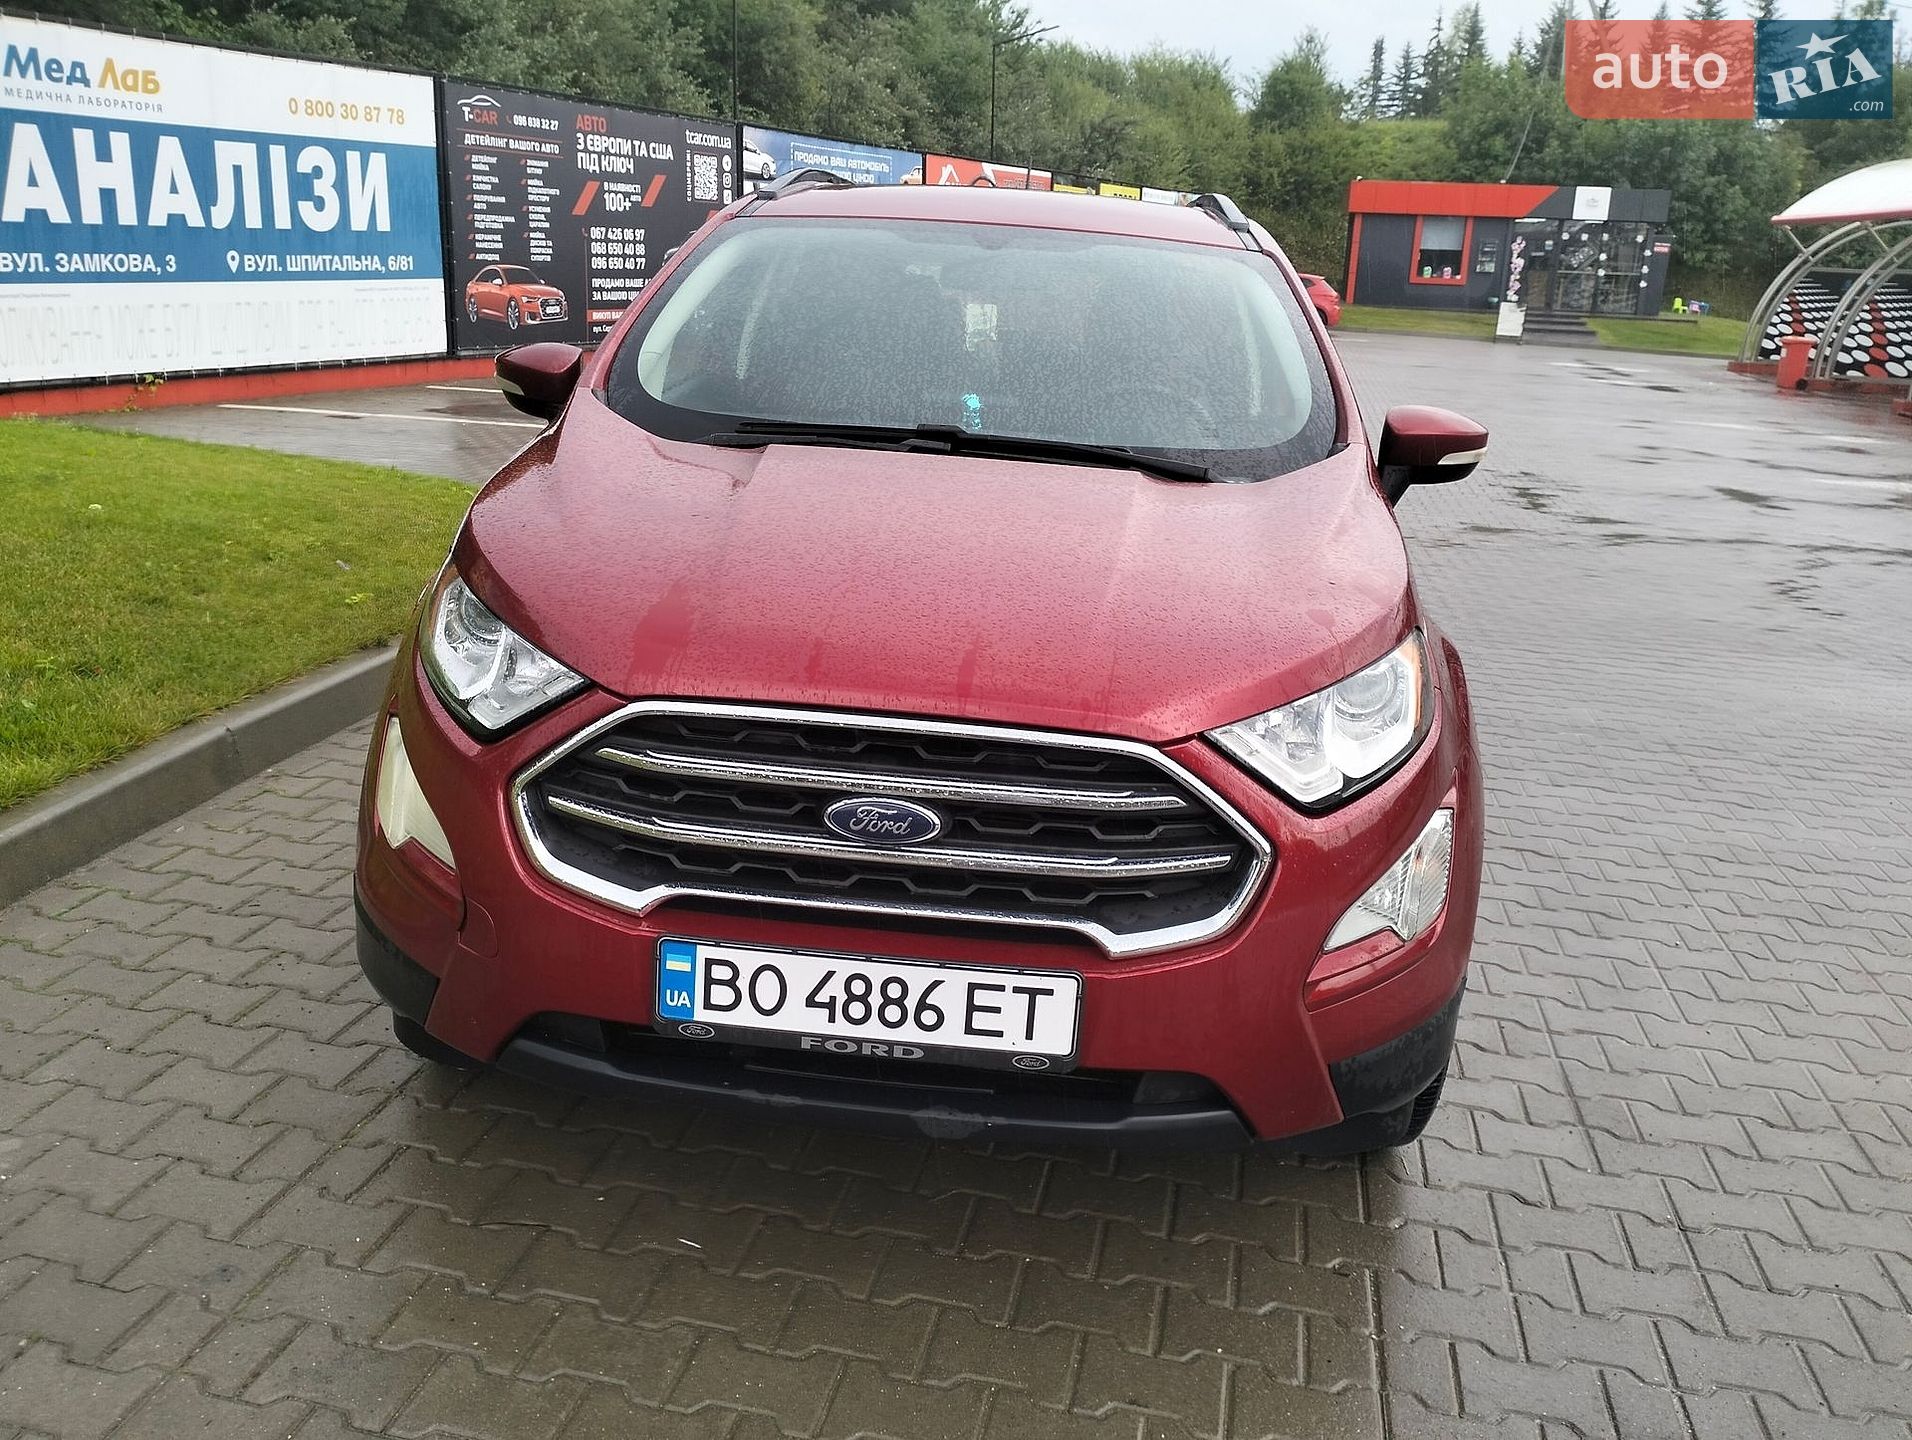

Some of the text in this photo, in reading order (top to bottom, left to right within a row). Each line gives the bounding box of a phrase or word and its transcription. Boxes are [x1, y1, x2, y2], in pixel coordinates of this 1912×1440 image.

[4, 44, 161, 95] Мед Лаб
[4, 87, 163, 113] МЕДИЧНА ЛАБОРАТОРІЯ
[288, 97, 405, 125] 0 800 30 87 78
[576, 114, 607, 132] АВТО
[464, 133, 560, 155] ДЕТЕЙЛІНГ ВАШОГО АВТО
[587, 133, 632, 154] ЄВРОПИ
[633, 140, 648, 158] ТА
[649, 142, 674, 161] США
[685, 129, 732, 149] tcar.com.ua
[577, 152, 635, 175] ПІД КЛЮЧ
[1, 122, 391, 233] АНАЛІЗИ
[603, 192, 632, 212] 100+
[590, 226, 646, 241] 067 426 06 97
[590, 241, 646, 256] 068 650 40 88
[0, 252, 177, 276] ВУЛ. ЗАМКОВА, 3
[243, 254, 414, 274] ВУЛ. ШПИТАЛЬНА, 6/81
[591, 256, 646, 270] 096 650 40 77
[591, 278, 625, 290] ПРОДАМО
[625, 278, 644, 289] ВАШЕ
[591, 290, 602, 301] ЗА
[849, 806, 913, 835] Ford
[666, 989, 691, 1009] UA
[702, 957, 1055, 1042] BO 4886 ET
[801, 1036, 925, 1061] FORD
